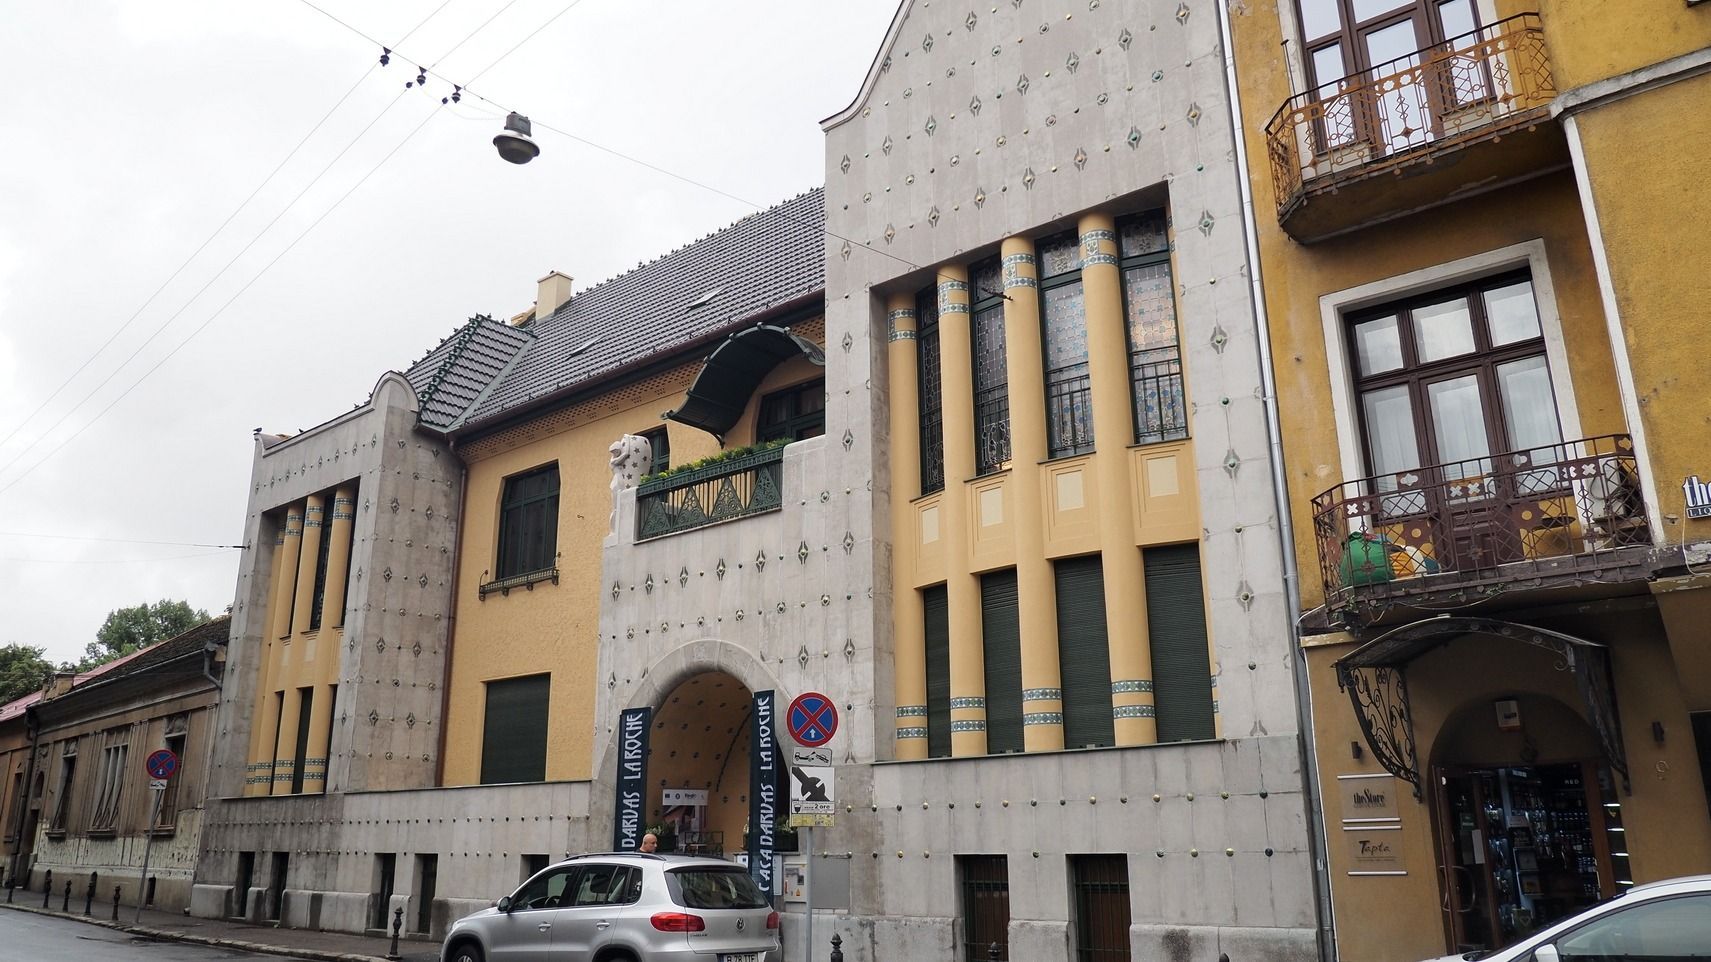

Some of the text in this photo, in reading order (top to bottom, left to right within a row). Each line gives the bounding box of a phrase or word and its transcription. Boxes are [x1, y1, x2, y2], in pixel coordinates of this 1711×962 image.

[758, 696, 772, 748] ROCHE
[621, 791, 641, 848] DARVAS
[760, 783, 774, 846] DARVAS
